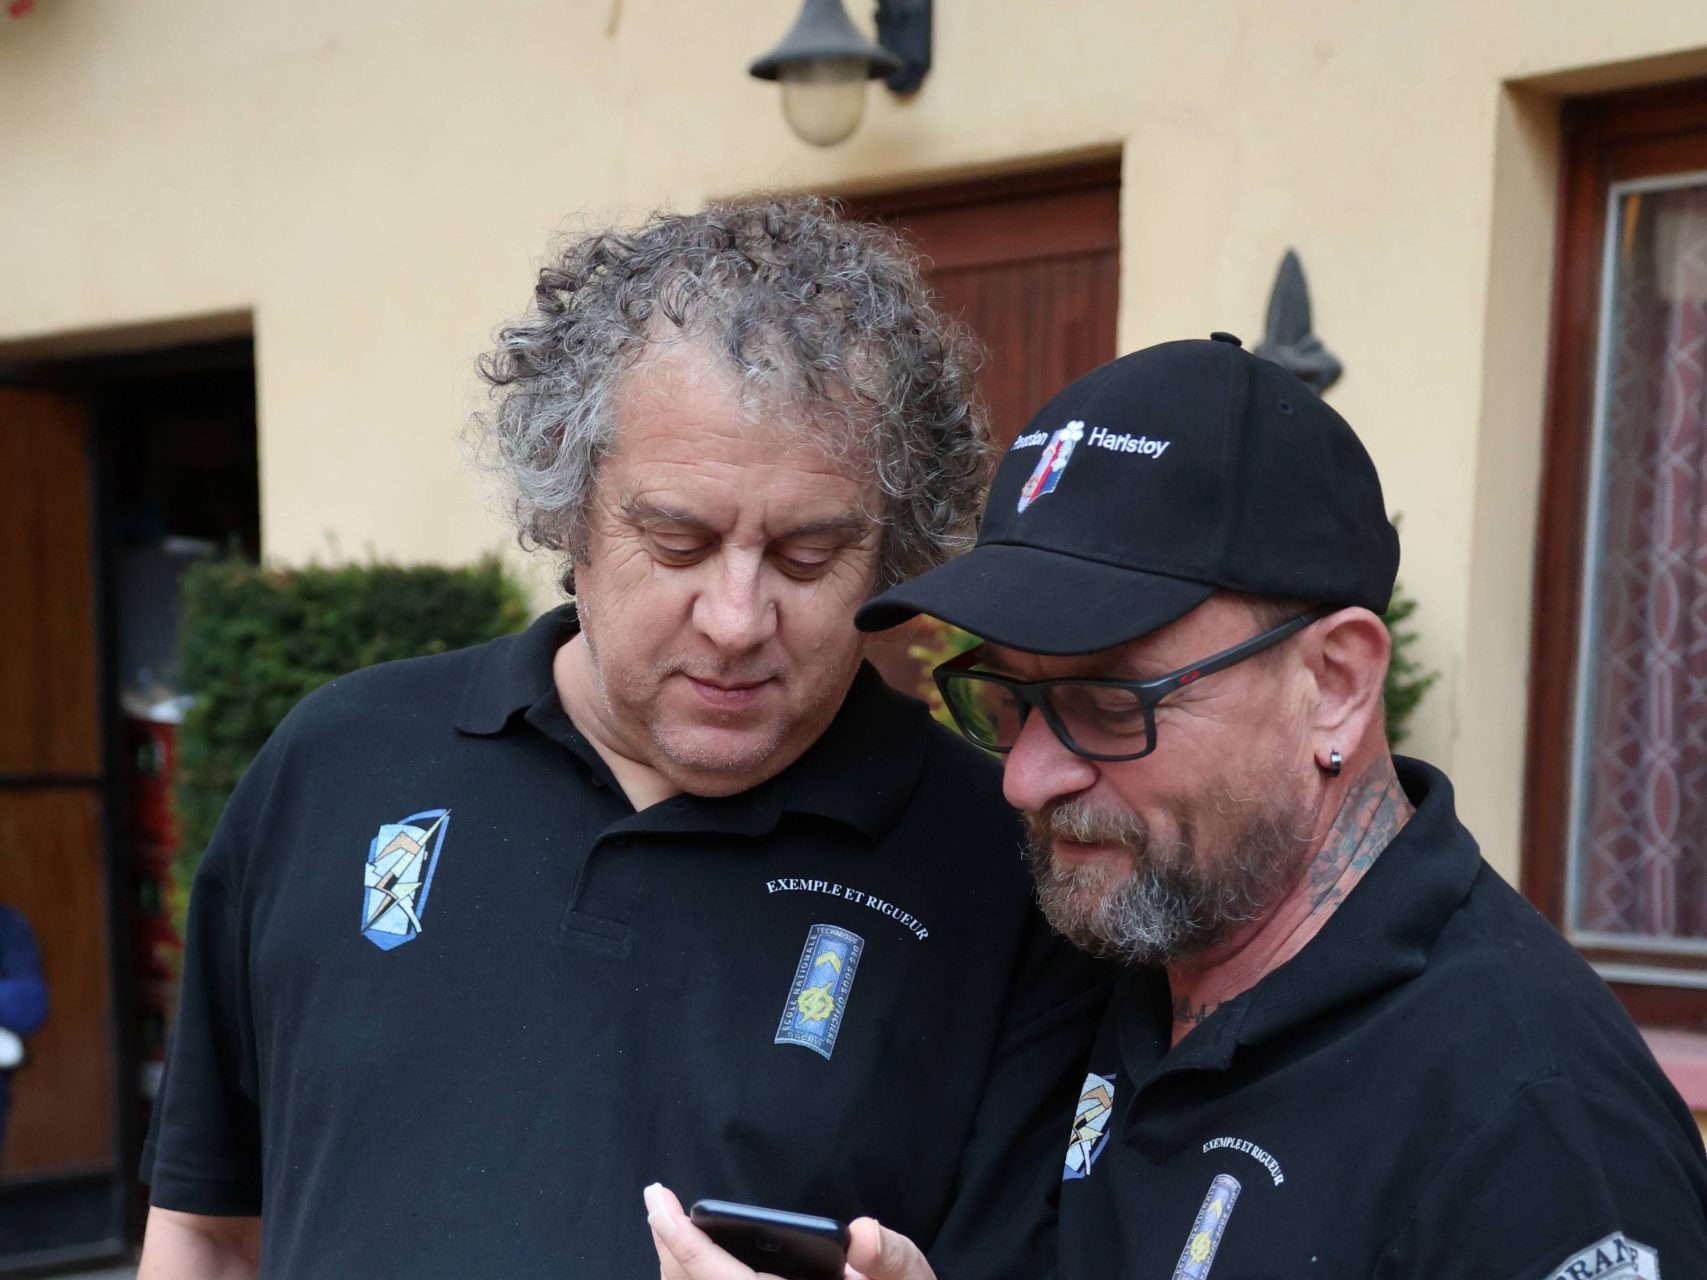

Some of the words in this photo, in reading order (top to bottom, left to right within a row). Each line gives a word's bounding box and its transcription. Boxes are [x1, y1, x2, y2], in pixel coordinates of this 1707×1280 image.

[1087, 426, 1171, 459] Haristoy
[766, 878, 843, 896] EXEMPLE
[843, 888, 865, 903] ET
[865, 896, 929, 941] RIGUEUR
[782, 1000, 798, 1031] ECOLE
[793, 934, 818, 996] NATIONALE
[1202, 1136, 1241, 1154] EXEMPLE
[1240, 1140, 1253, 1154] ET
[1250, 1145, 1285, 1187] RIGUEUR
